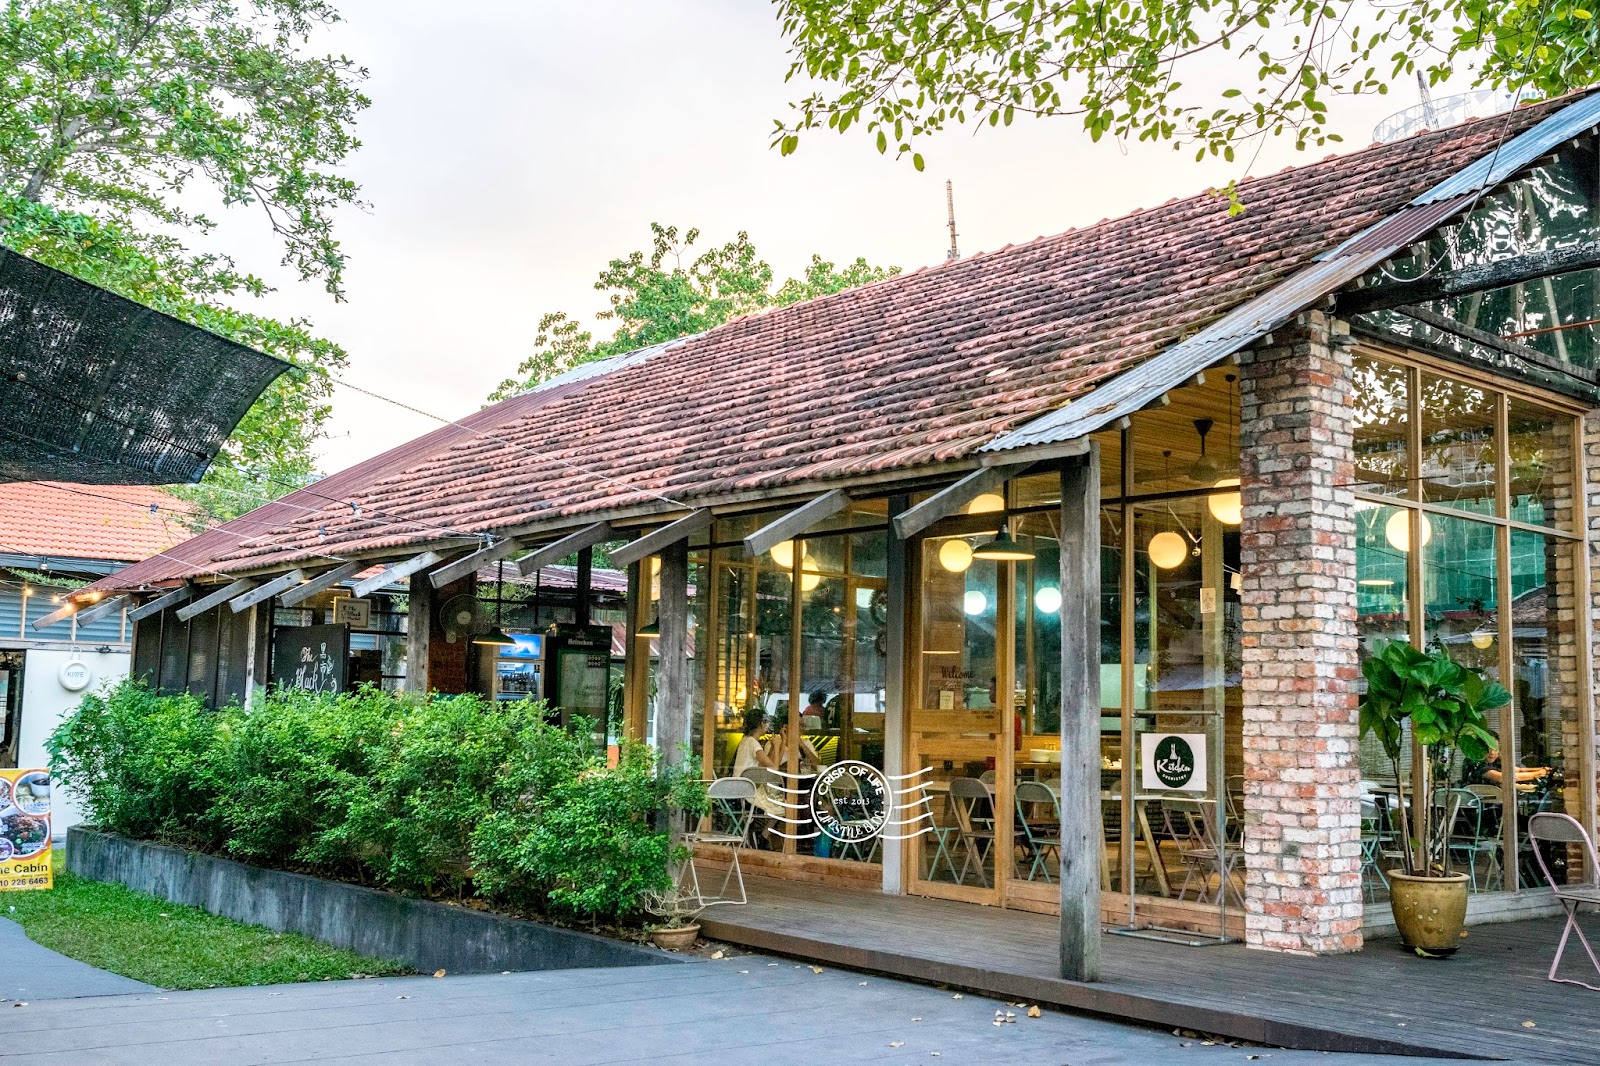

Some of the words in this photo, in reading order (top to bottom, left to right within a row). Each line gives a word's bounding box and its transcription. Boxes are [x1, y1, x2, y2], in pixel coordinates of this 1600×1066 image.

[301, 646, 318, 662] The
[941, 665, 975, 679] Welcome
[1156, 756, 1191, 773] Kitchen
[1162, 773, 1187, 781] CHEMISTRY
[14, 863, 48, 873] Cabin
[11, 878, 26, 887] 226
[28, 877, 49, 885] 6463
